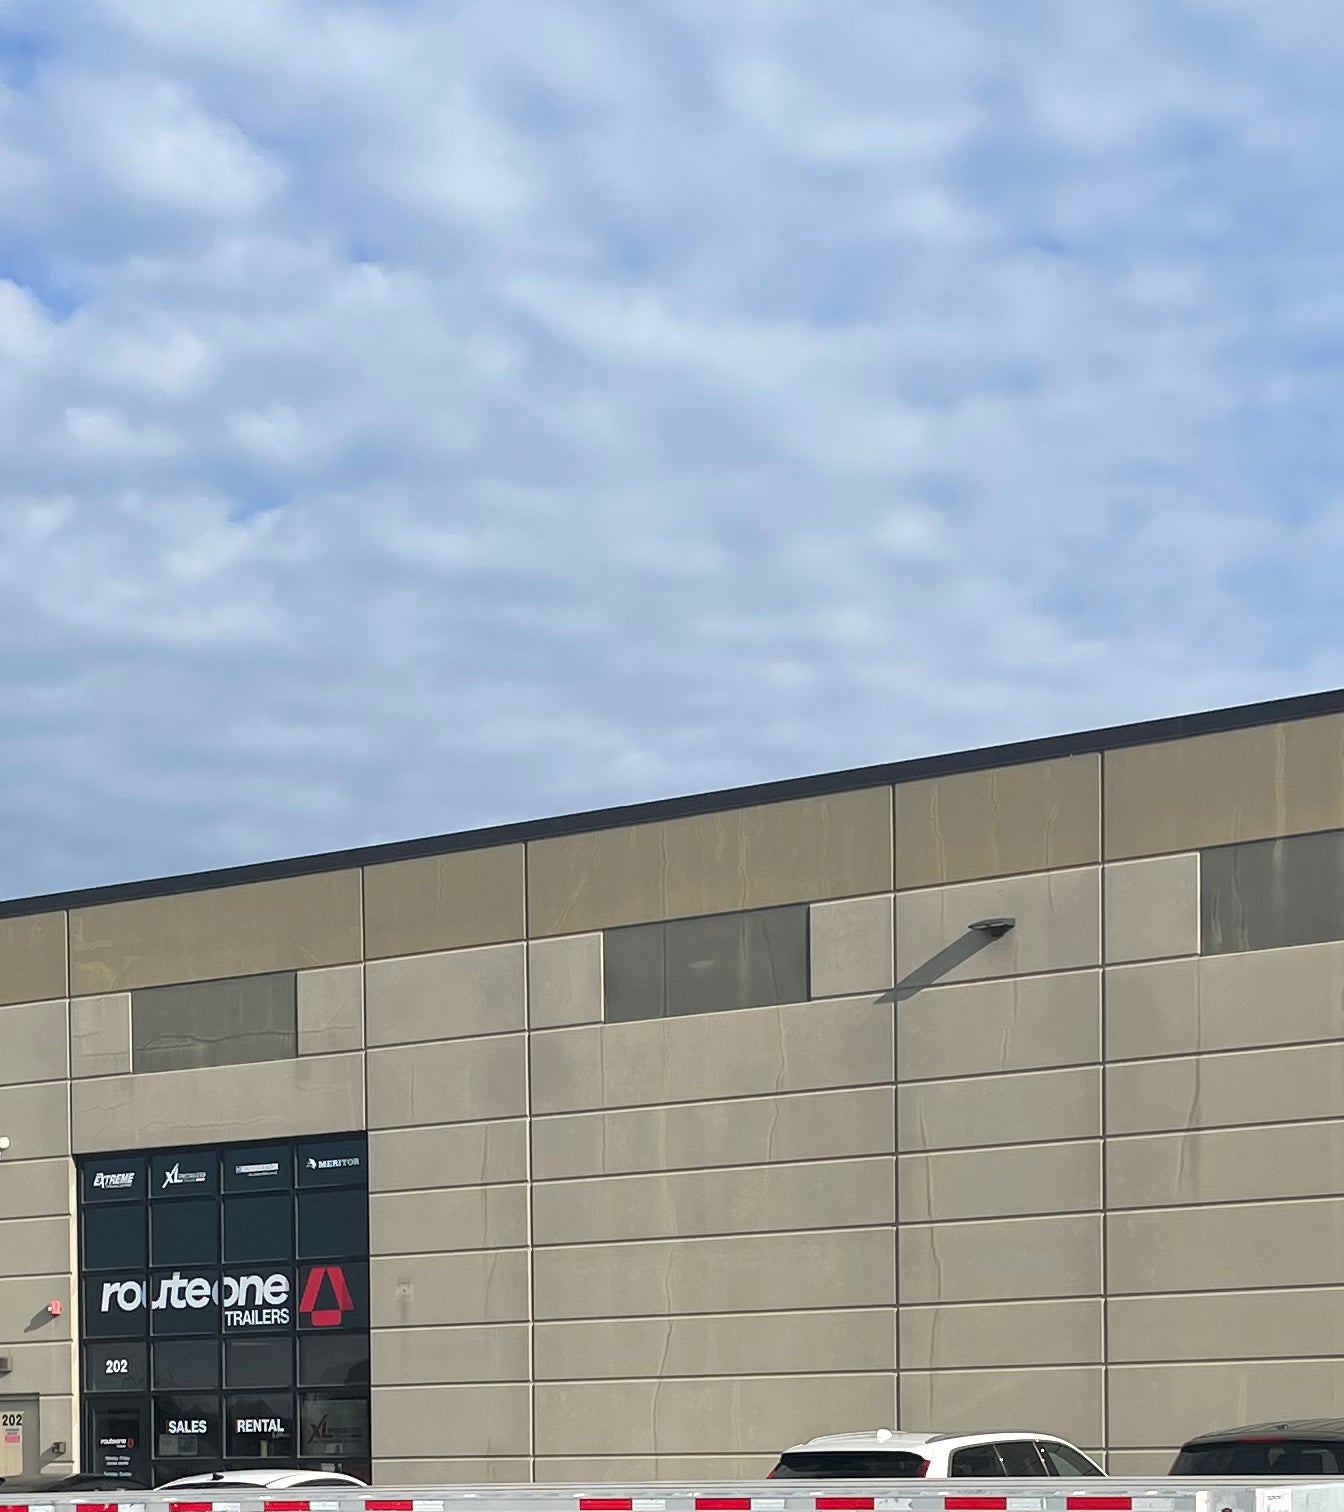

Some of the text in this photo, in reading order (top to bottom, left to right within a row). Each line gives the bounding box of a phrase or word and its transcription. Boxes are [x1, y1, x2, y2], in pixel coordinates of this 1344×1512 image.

[318, 1157, 360, 1169] MERITOR
[93, 1172, 136, 1189] EXTREME
[162, 1163, 184, 1188] XL
[101, 1271, 291, 1312] routeone
[225, 1308, 291, 1327] TRAILERS
[105, 1359, 128, 1373] 202
[2, 1414, 23, 1426] 202
[168, 1420, 208, 1434] SALES
[236, 1418, 285, 1433] RENTAL
